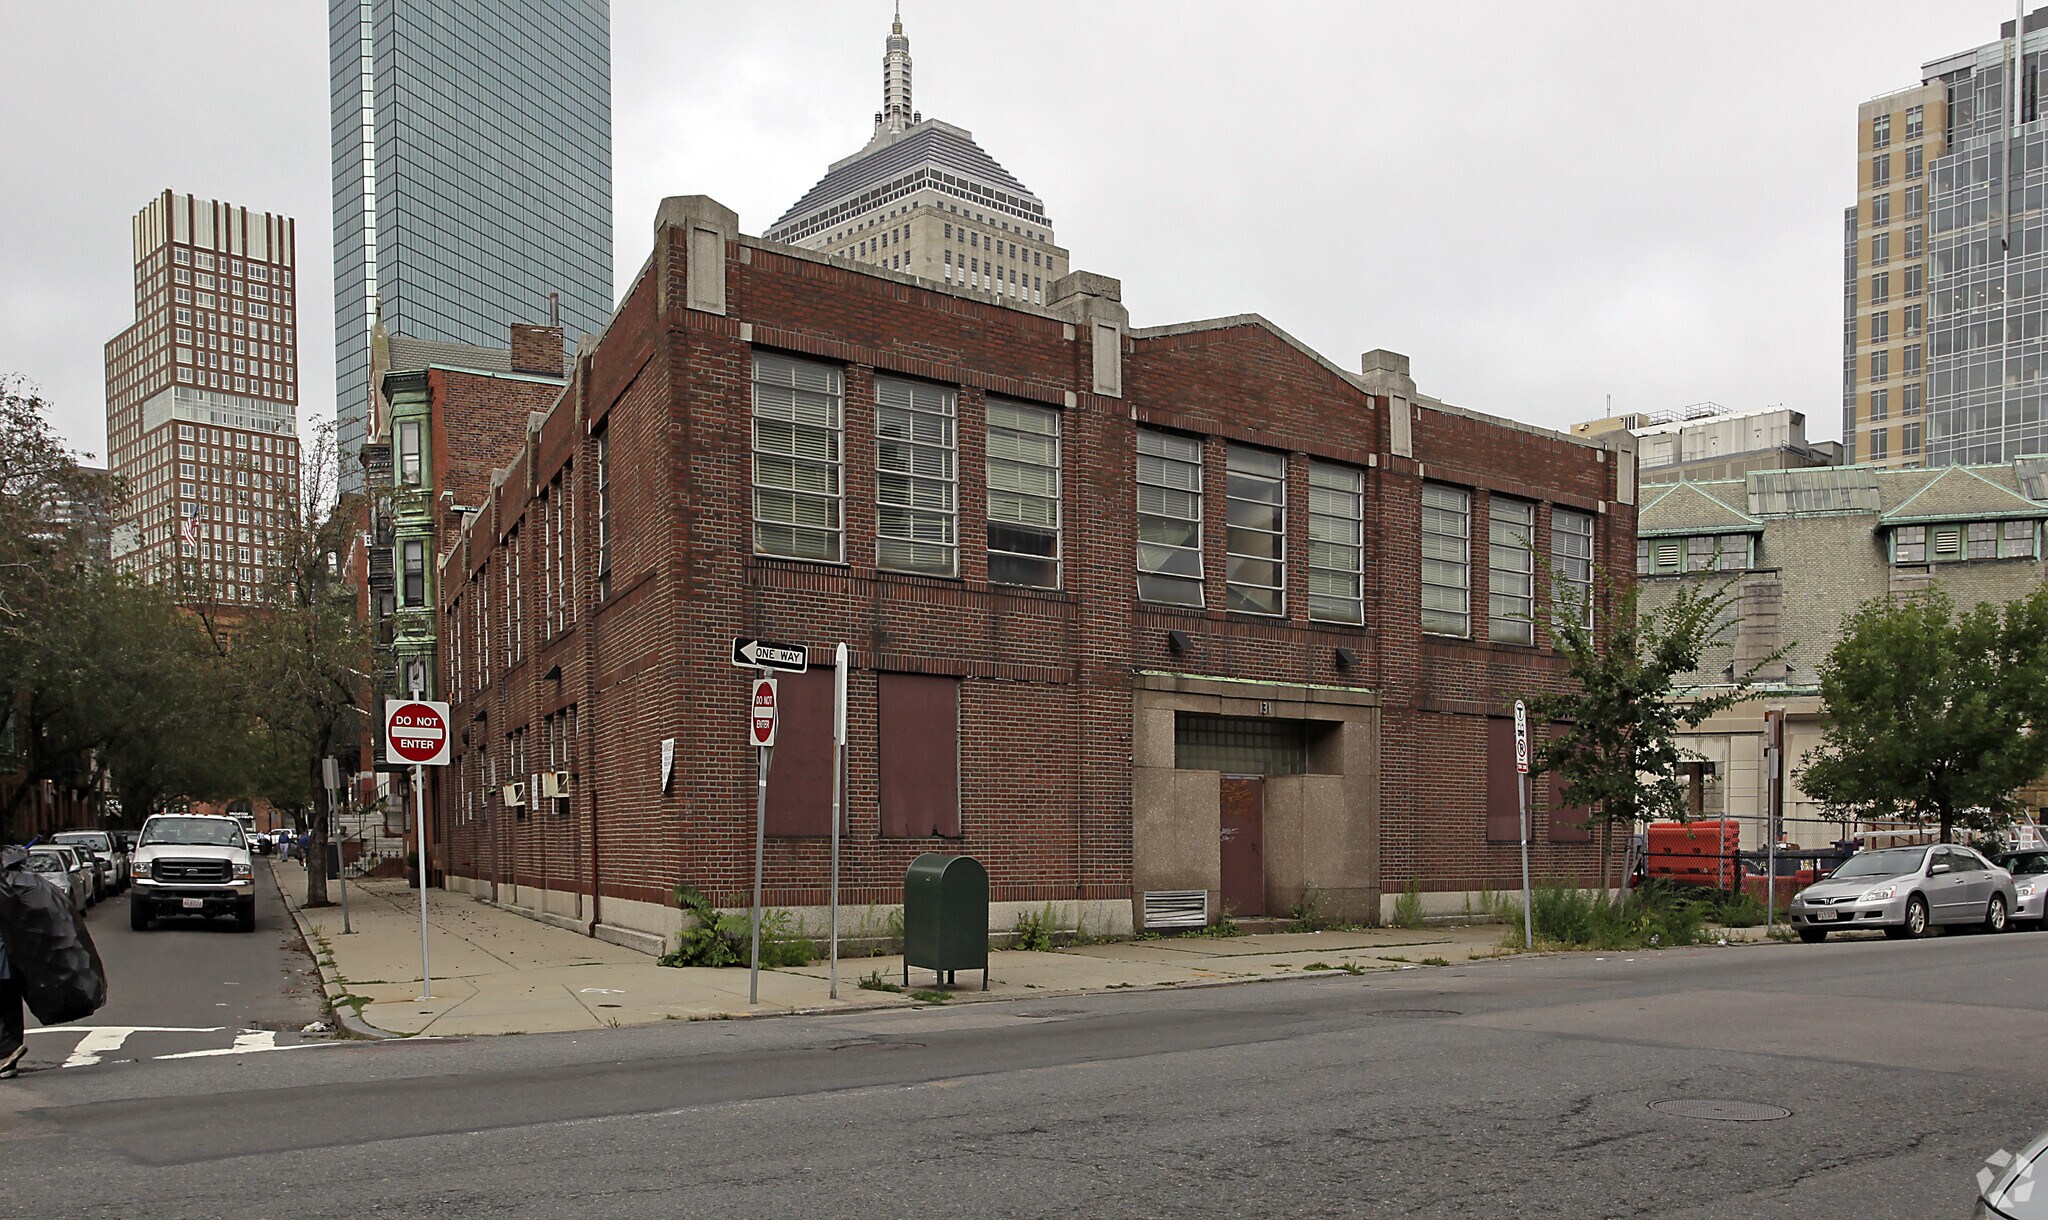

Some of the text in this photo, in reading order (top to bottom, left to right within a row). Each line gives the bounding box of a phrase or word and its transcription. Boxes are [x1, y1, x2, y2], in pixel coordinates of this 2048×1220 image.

[756, 647, 800, 662] ONE WAY
[756, 695, 773, 705] DO NOT
[396, 716, 438, 726] DO NOT
[756, 720, 770, 728] ENTER
[401, 739, 434, 749] ENTER
